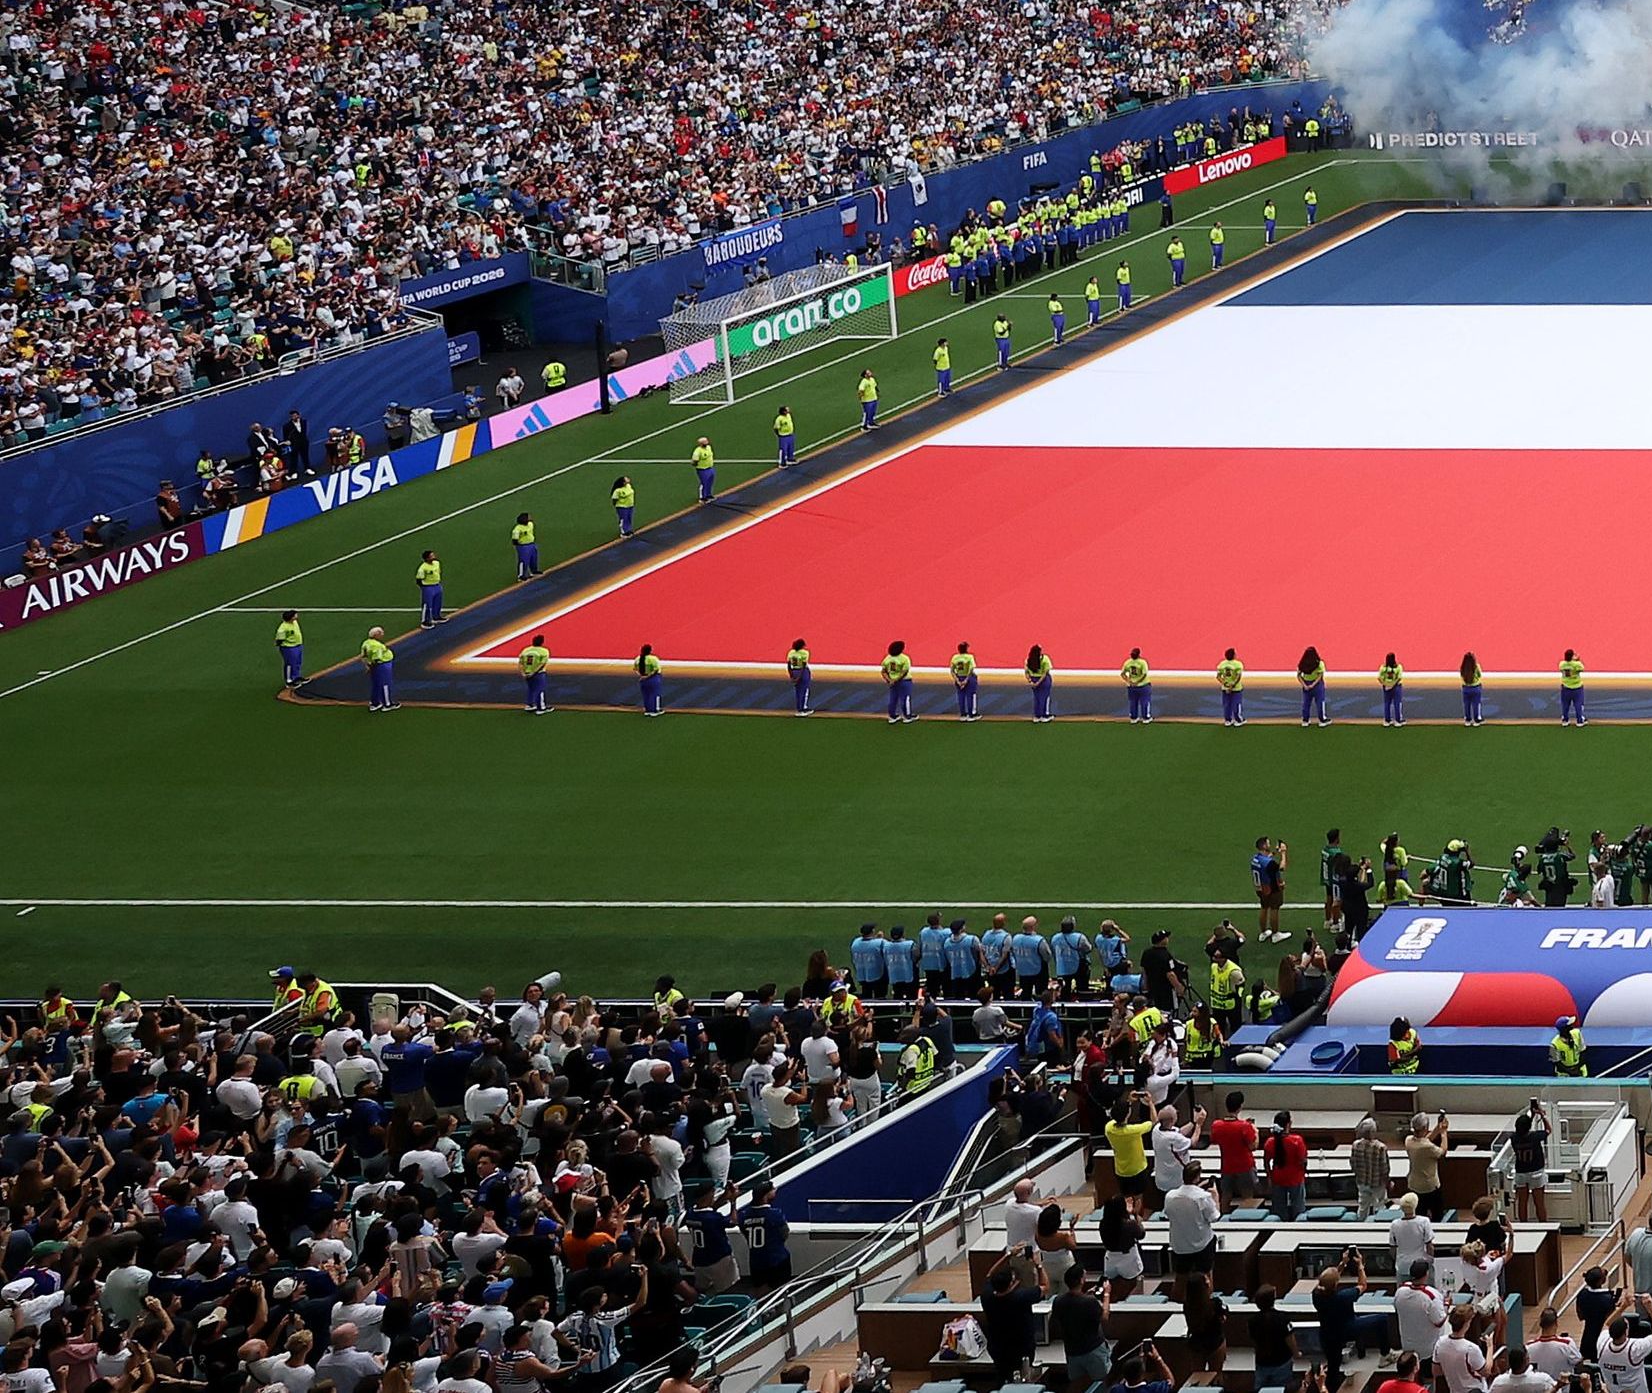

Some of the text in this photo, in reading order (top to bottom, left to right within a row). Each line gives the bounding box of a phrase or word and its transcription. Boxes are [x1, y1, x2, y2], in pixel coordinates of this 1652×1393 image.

[1023, 151, 1047, 171] FIFA
[1199, 152, 1252, 184] Lenovo
[400, 268, 505, 305] IFA WORLD CUP 2026
[302, 454, 398, 513] VISA
[22, 530, 190, 619] AIRWAYS
[382, 1050, 404, 1061] FRANCE
[315, 1131, 337, 1154] 10
[747, 1226, 765, 1249] 10
